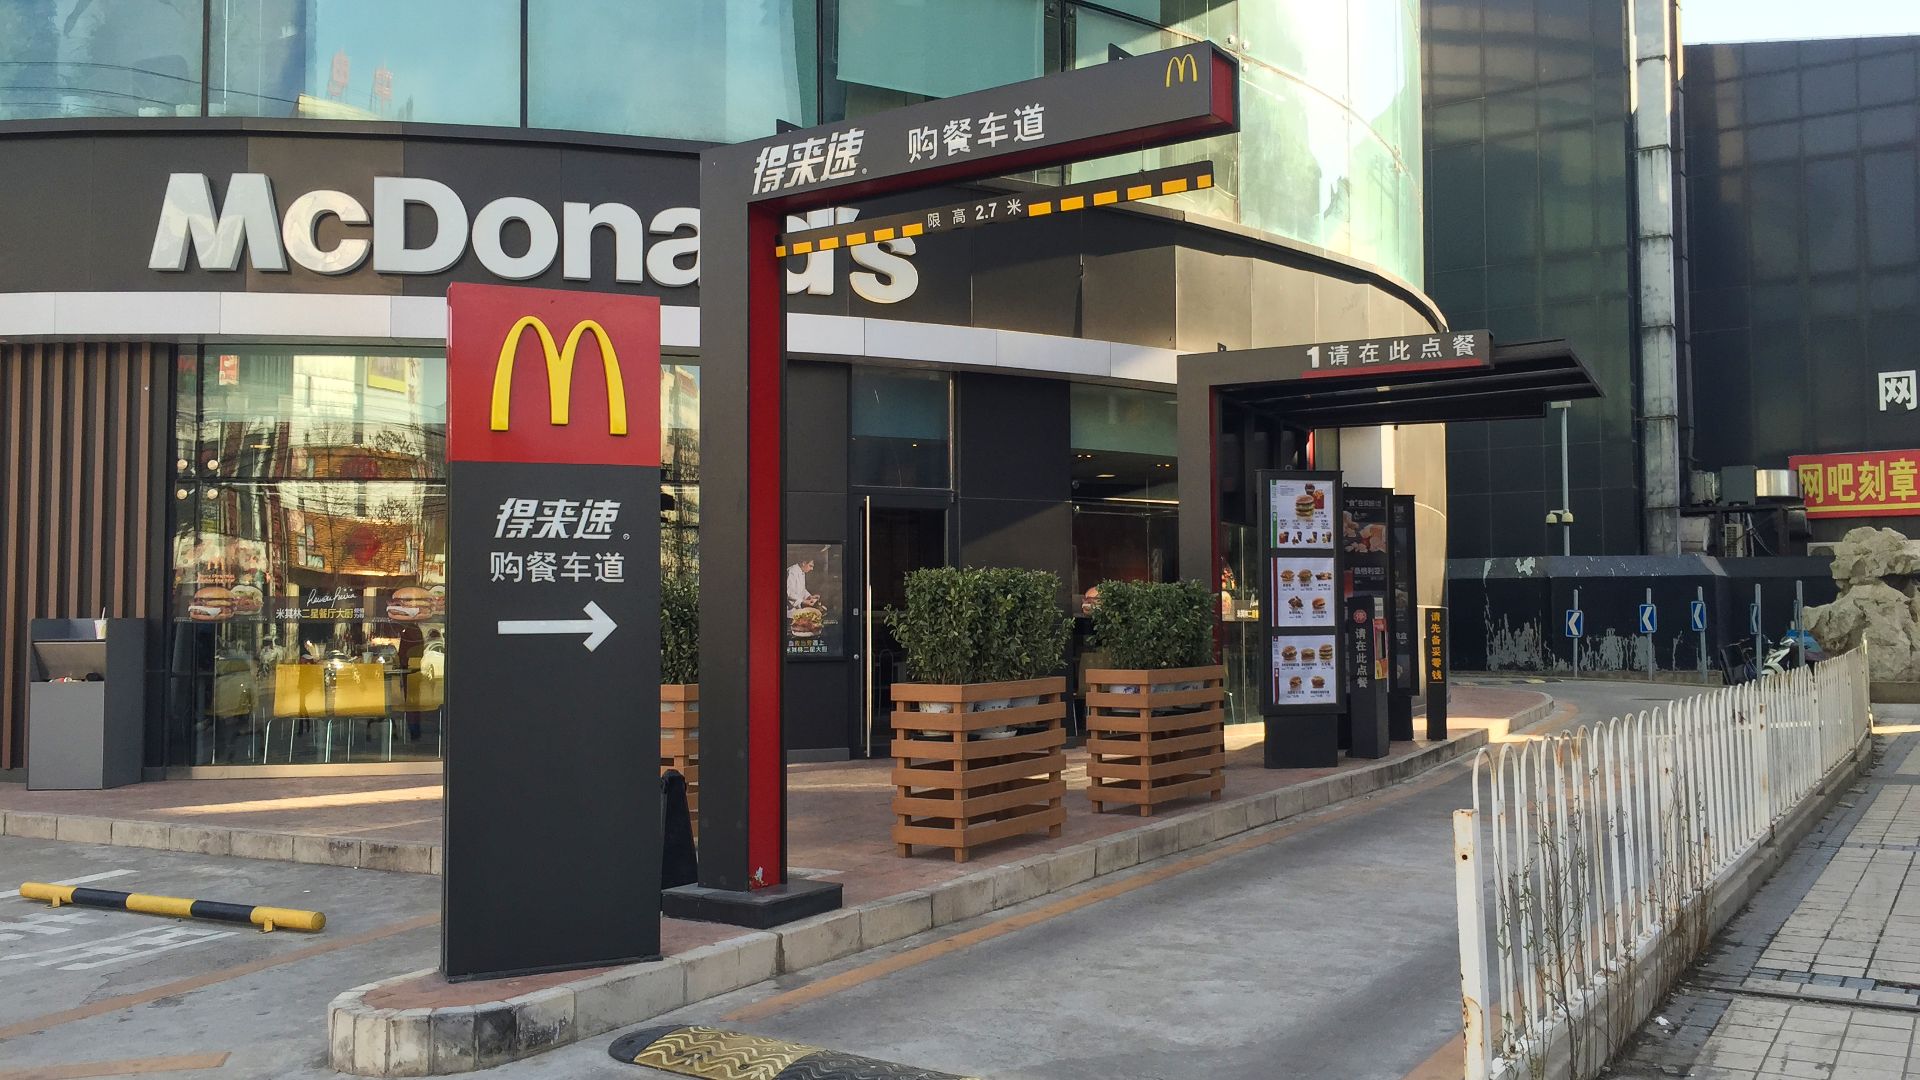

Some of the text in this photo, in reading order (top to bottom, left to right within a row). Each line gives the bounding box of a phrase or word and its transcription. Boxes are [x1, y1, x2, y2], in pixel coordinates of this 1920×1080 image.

[752, 103, 1045, 195] 得来速 购餐车道
[1878, 369, 1918, 412] 网
[1798, 457, 1918, 504] 网吧刻章
[494, 497, 621, 540] 得来速
[490, 550, 625, 583] 购餐车道
[1355, 628, 1368, 688] 请在此点餐
[1431, 611, 1442, 680] 请先备妥零钱
